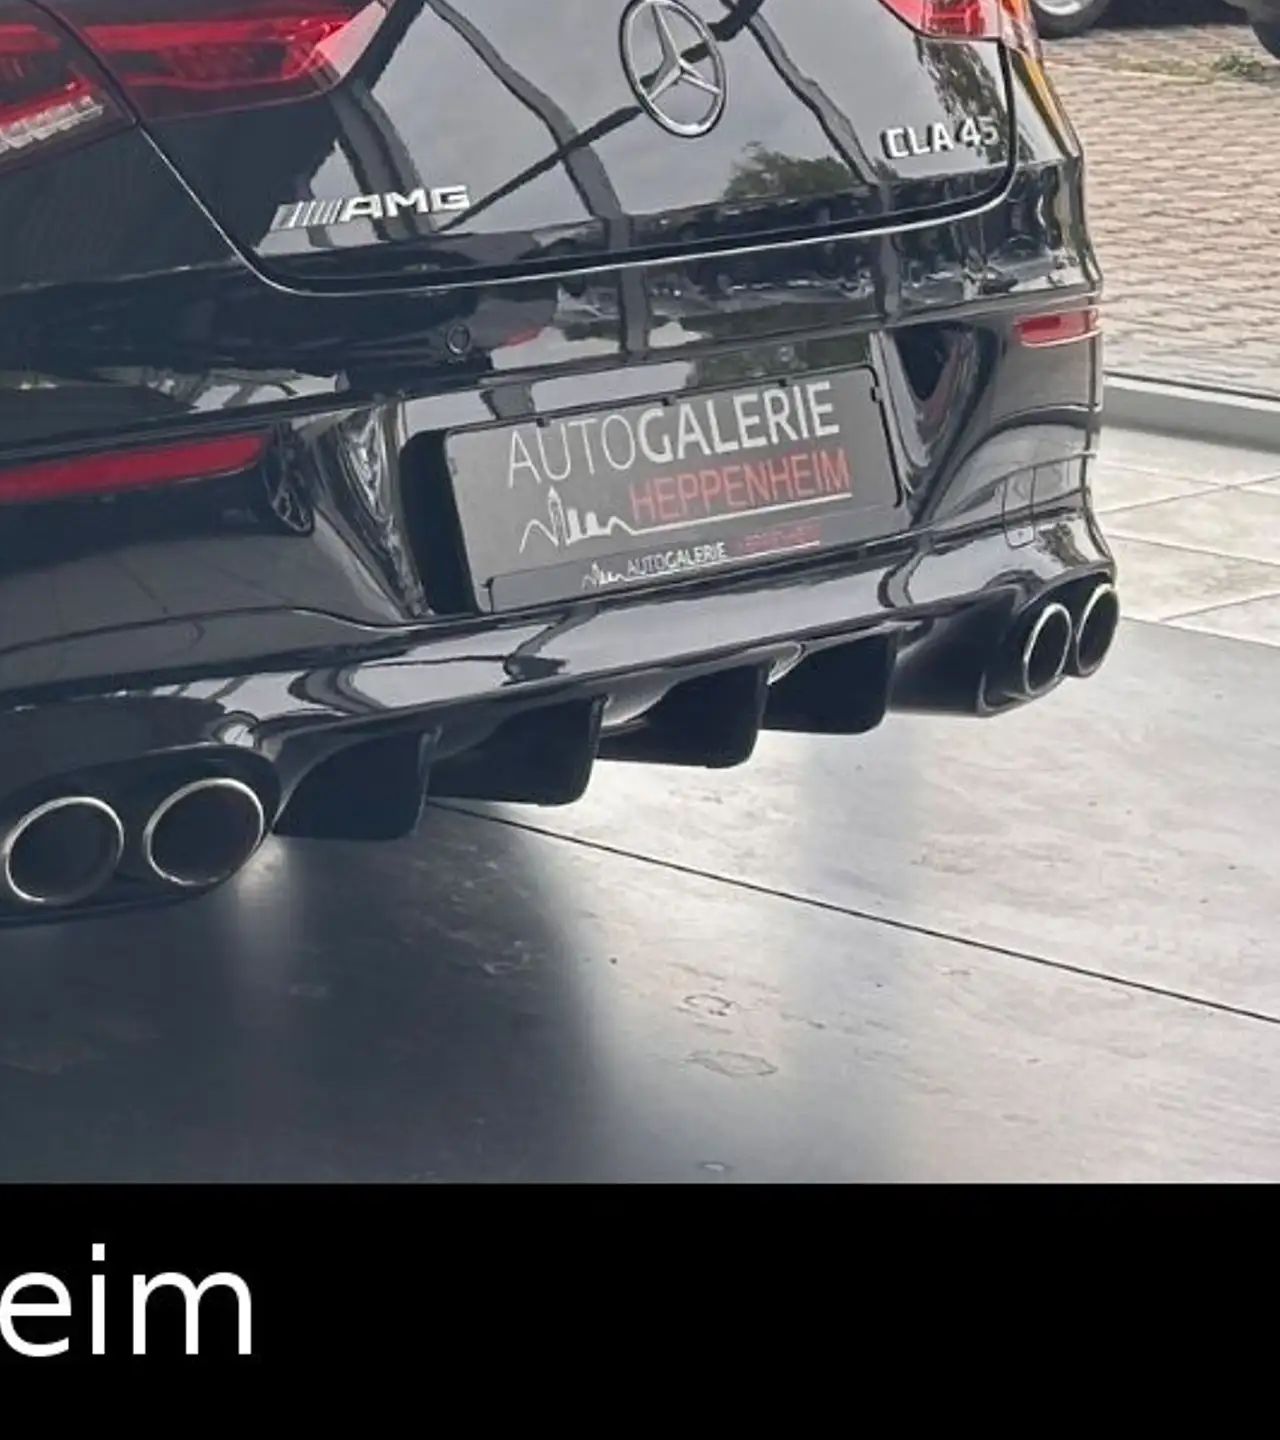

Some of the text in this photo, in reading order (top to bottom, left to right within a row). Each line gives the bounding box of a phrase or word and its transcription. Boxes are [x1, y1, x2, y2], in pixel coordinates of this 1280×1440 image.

[882, 116, 1000, 158] CLA 45
[339, 184, 470, 222] AMG
[508, 380, 840, 488] AUTOGALERIE
[629, 447, 851, 522] HEPPENHEIM
